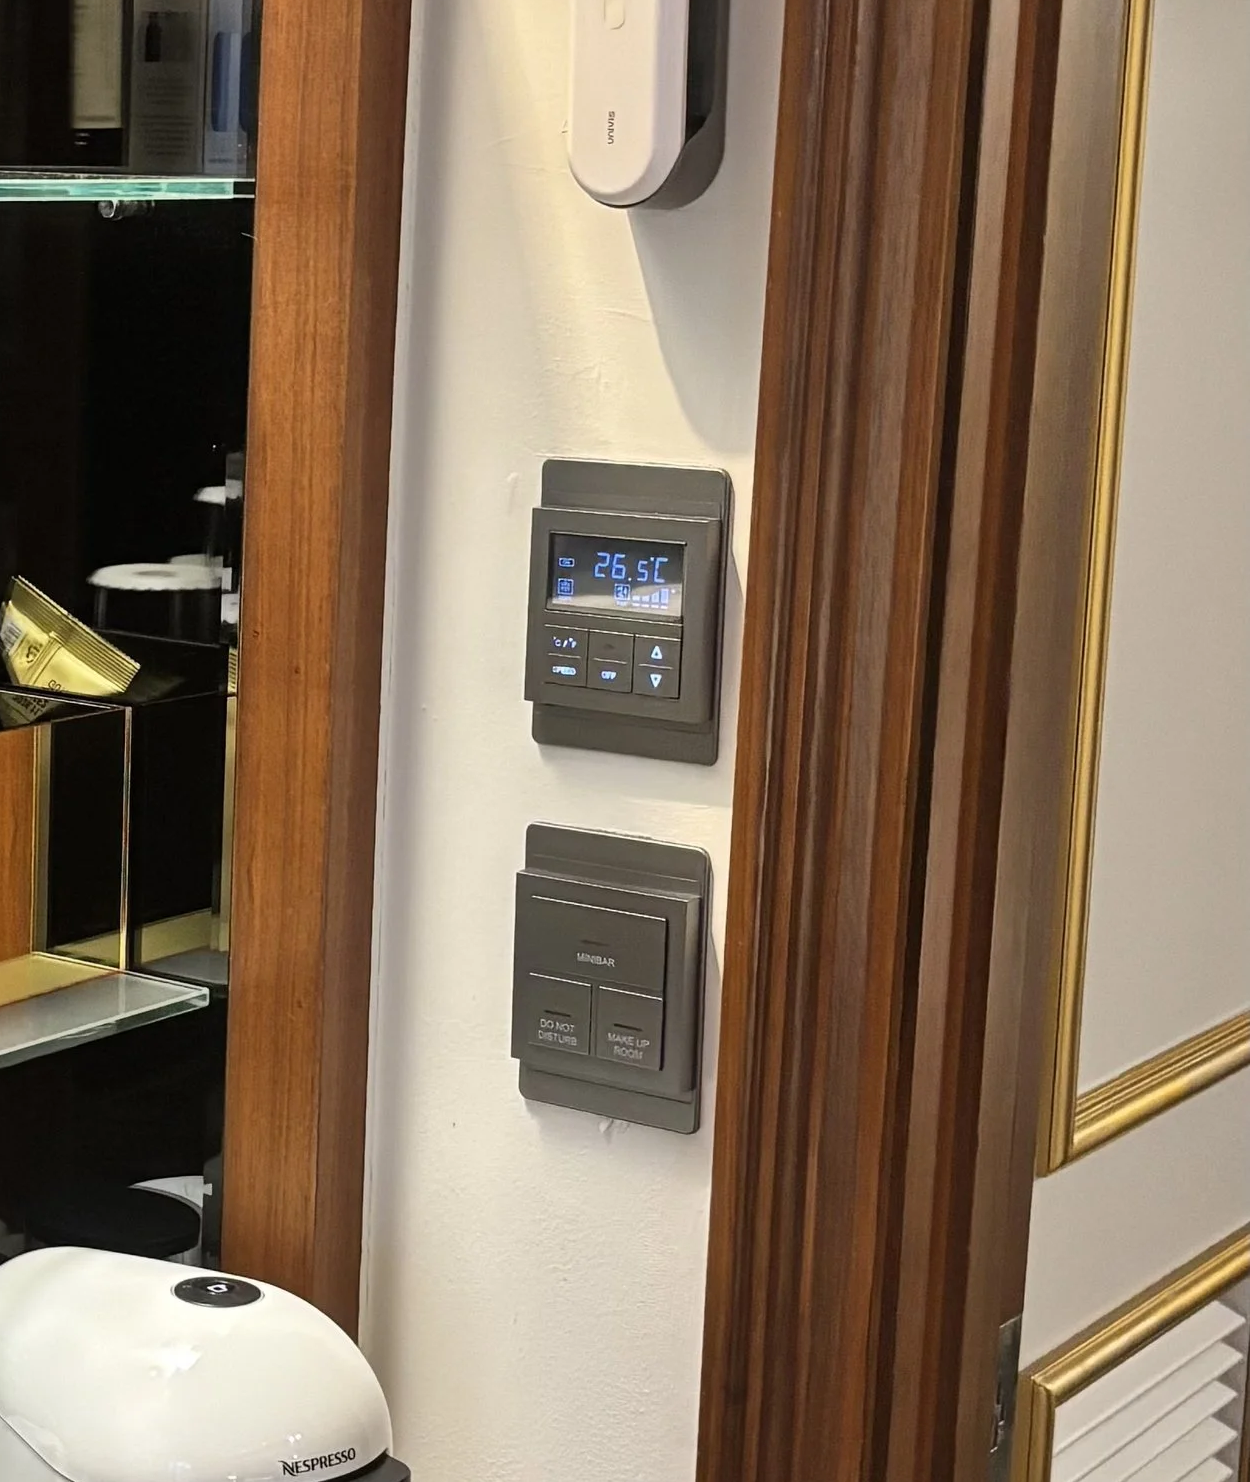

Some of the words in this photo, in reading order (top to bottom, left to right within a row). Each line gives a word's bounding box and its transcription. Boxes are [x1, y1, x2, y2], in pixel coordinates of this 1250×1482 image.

[576, 952, 615, 967] MINIBAR
[539, 1018, 554, 1029] DO
[555, 1021, 575, 1033] NOT
[538, 1030, 578, 1047] DISTURB
[607, 1032, 634, 1047] MAKE
[636, 1038, 650, 1048] UP
[613, 1045, 643, 1060] ROOM
[278, 1447, 357, 1477] NESPRESSO
